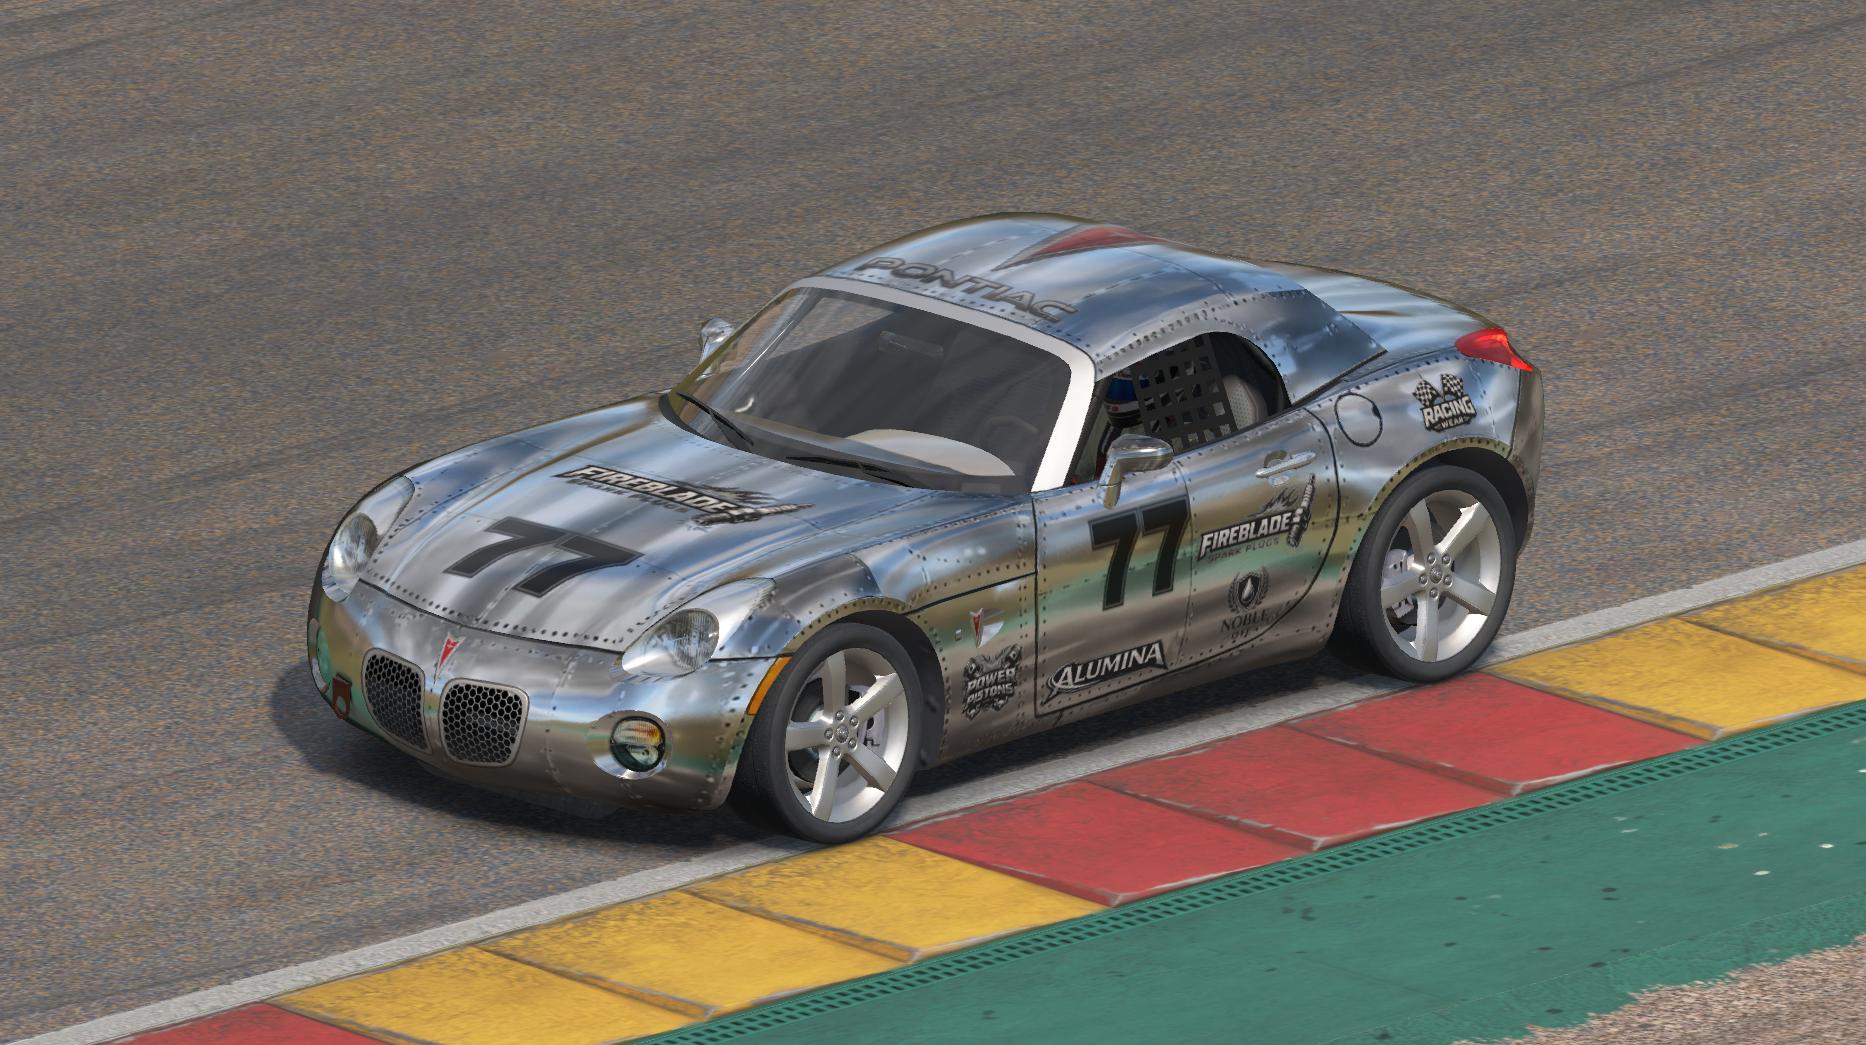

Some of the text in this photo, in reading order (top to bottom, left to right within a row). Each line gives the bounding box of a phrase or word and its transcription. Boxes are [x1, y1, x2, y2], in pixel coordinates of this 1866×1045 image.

[854, 256, 1079, 323] PONTIAC
[1423, 396, 1475, 428] RACING
[560, 464, 740, 515] FIREBLADE
[442, 516, 645, 599] 77
[1088, 494, 1191, 612] 77
[1198, 511, 1293, 561] FIREBLADE
[967, 667, 1016, 694] POWER
[1051, 641, 1165, 692] ALUMINA
[966, 683, 1014, 704] PISTONS
